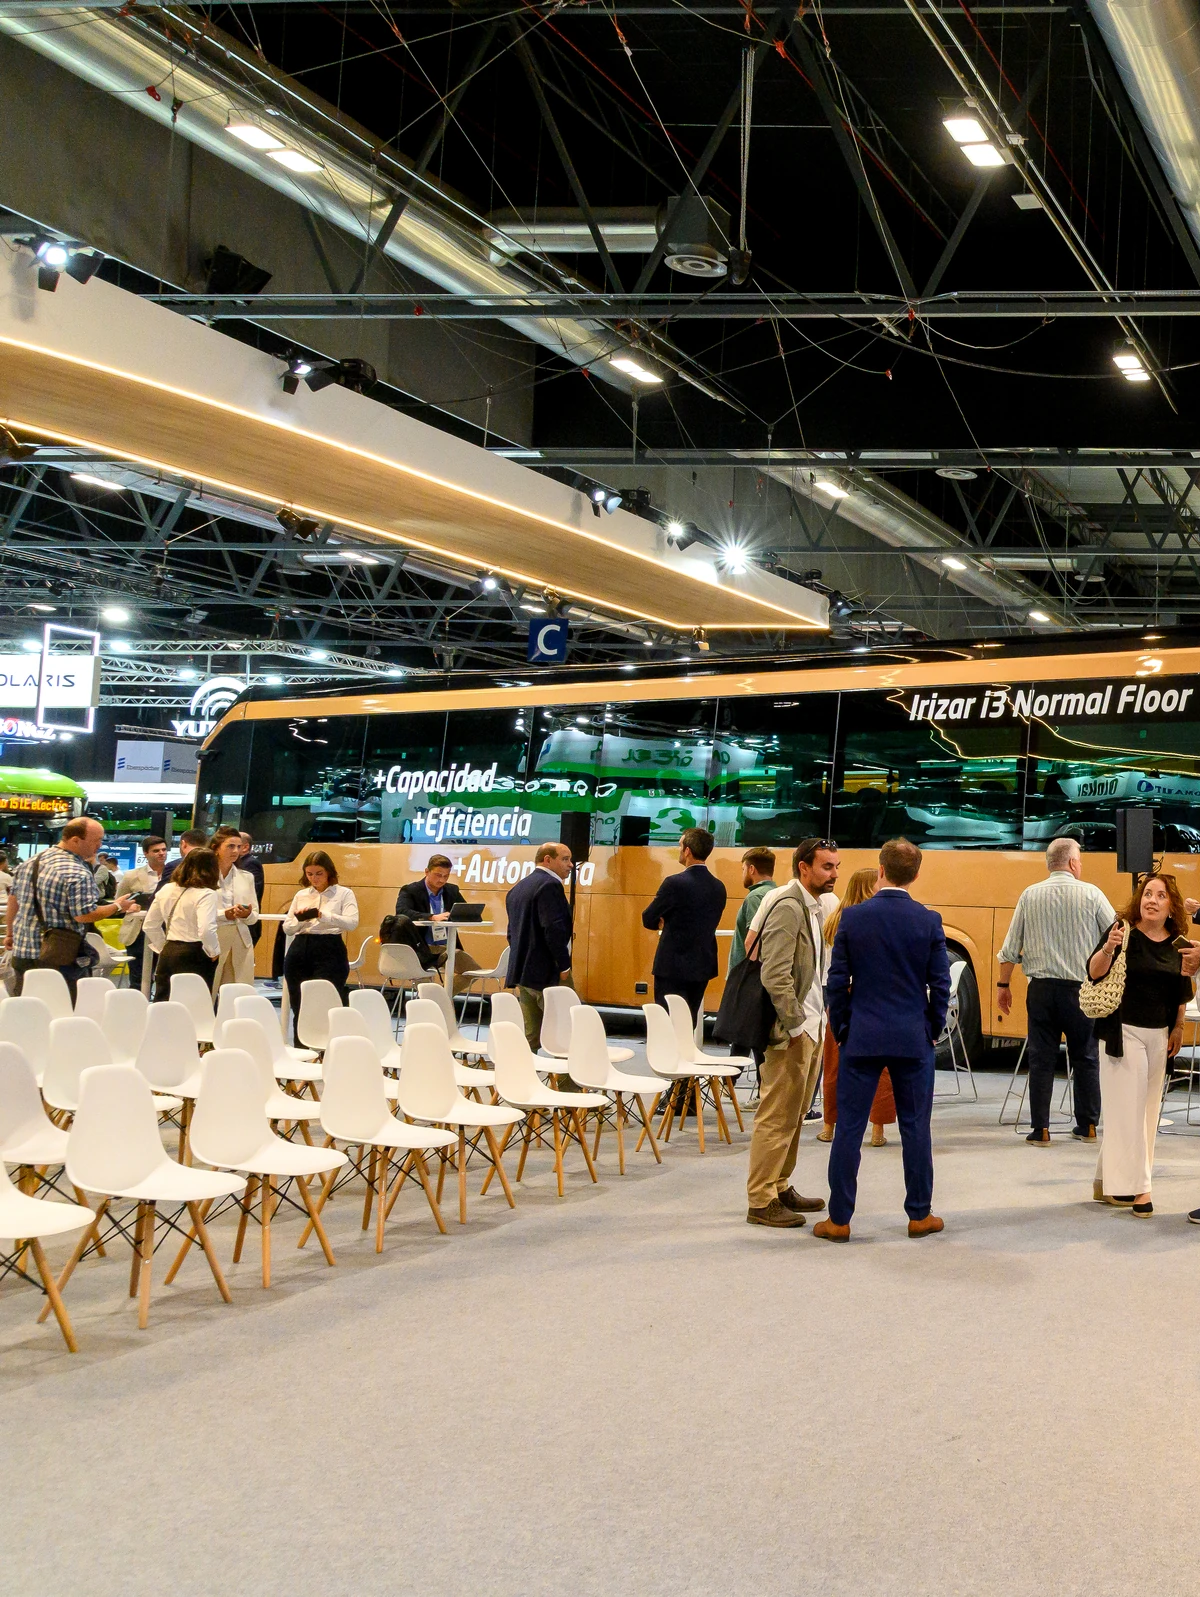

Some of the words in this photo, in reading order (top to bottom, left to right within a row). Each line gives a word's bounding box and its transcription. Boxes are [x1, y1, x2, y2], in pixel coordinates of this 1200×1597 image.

[537, 624, 561, 656] C
[0, 673, 76, 688] OLARIS
[909, 692, 976, 721] Irizar
[980, 690, 1007, 719] i3
[1012, 685, 1113, 718] Normal
[1117, 683, 1194, 714] Floor
[171, 720, 218, 737] YUT
[373, 762, 498, 800] +Capacidad
[9, 797, 19, 809] 15
[20, 797, 31, 810] LE
[31, 798, 69, 811] electric
[412, 806, 533, 842] +Eficiencia
[452, 854, 596, 886] +Autona
